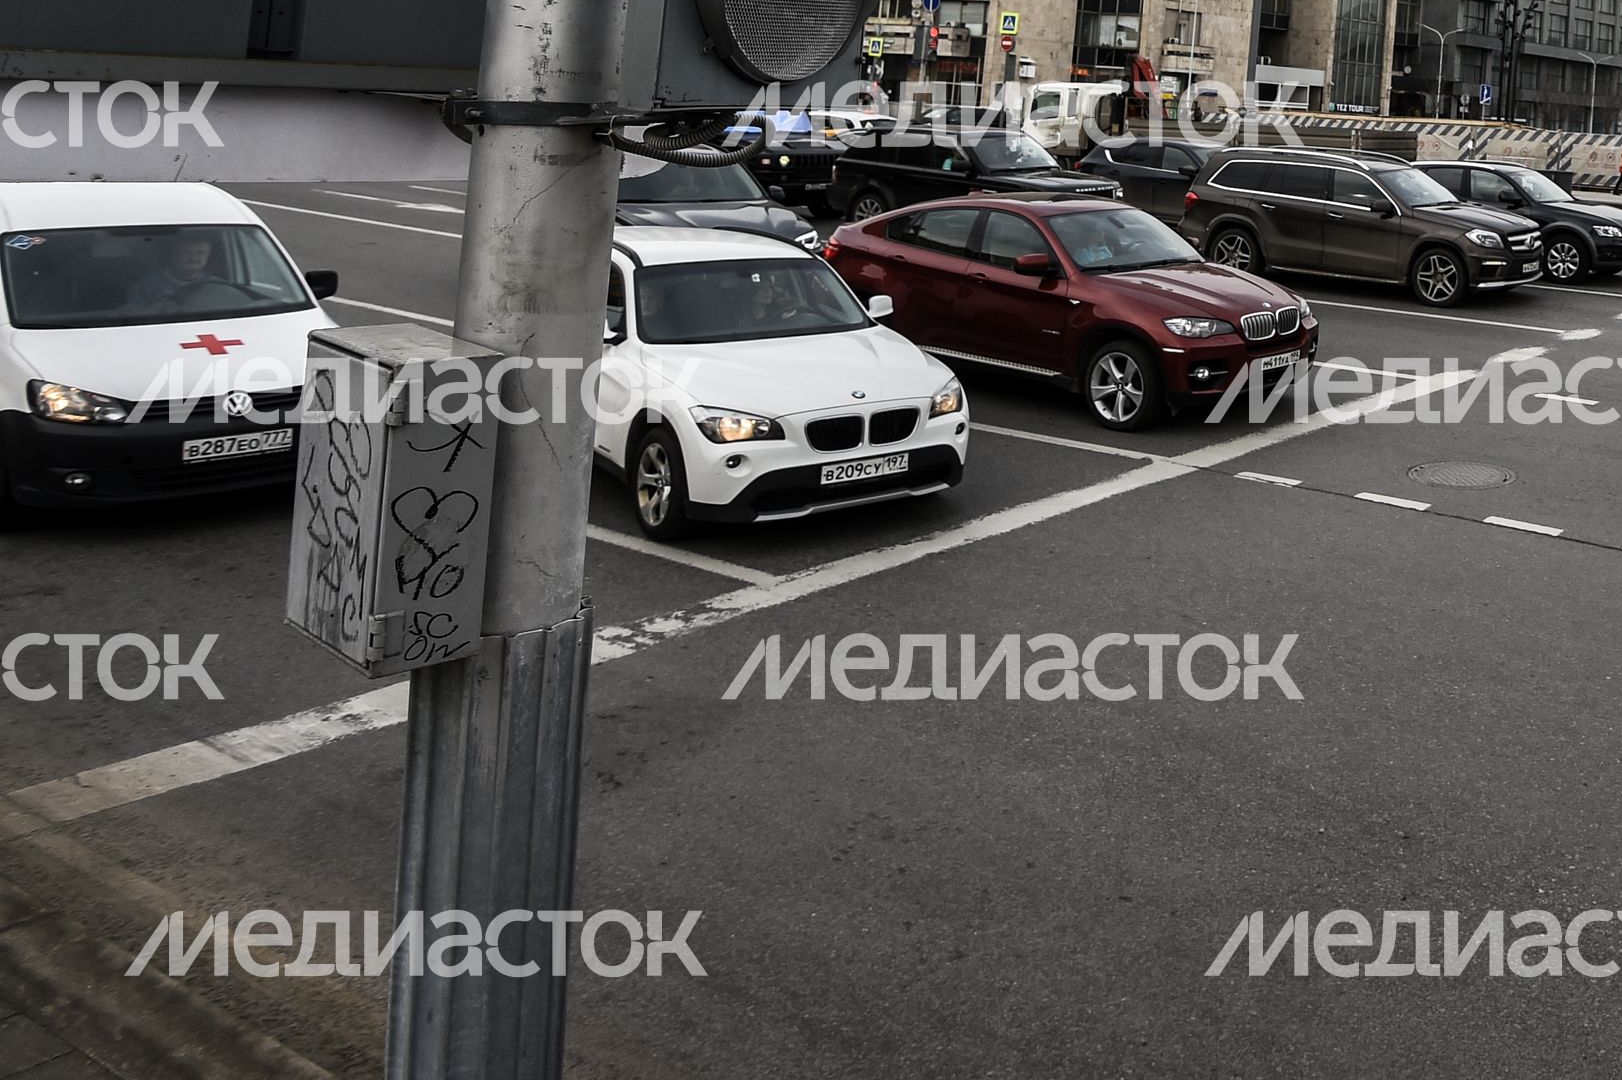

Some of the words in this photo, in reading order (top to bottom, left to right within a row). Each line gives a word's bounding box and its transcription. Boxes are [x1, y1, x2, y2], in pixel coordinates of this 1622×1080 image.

[1336, 103, 1347, 112] TEZ
[1348, 104, 1364, 113] TOUR
[188, 437, 261, 457] В287ЕО
[263, 430, 289, 444] 777
[825, 462, 882, 482] В209СУ
[885, 454, 905, 468] 197
